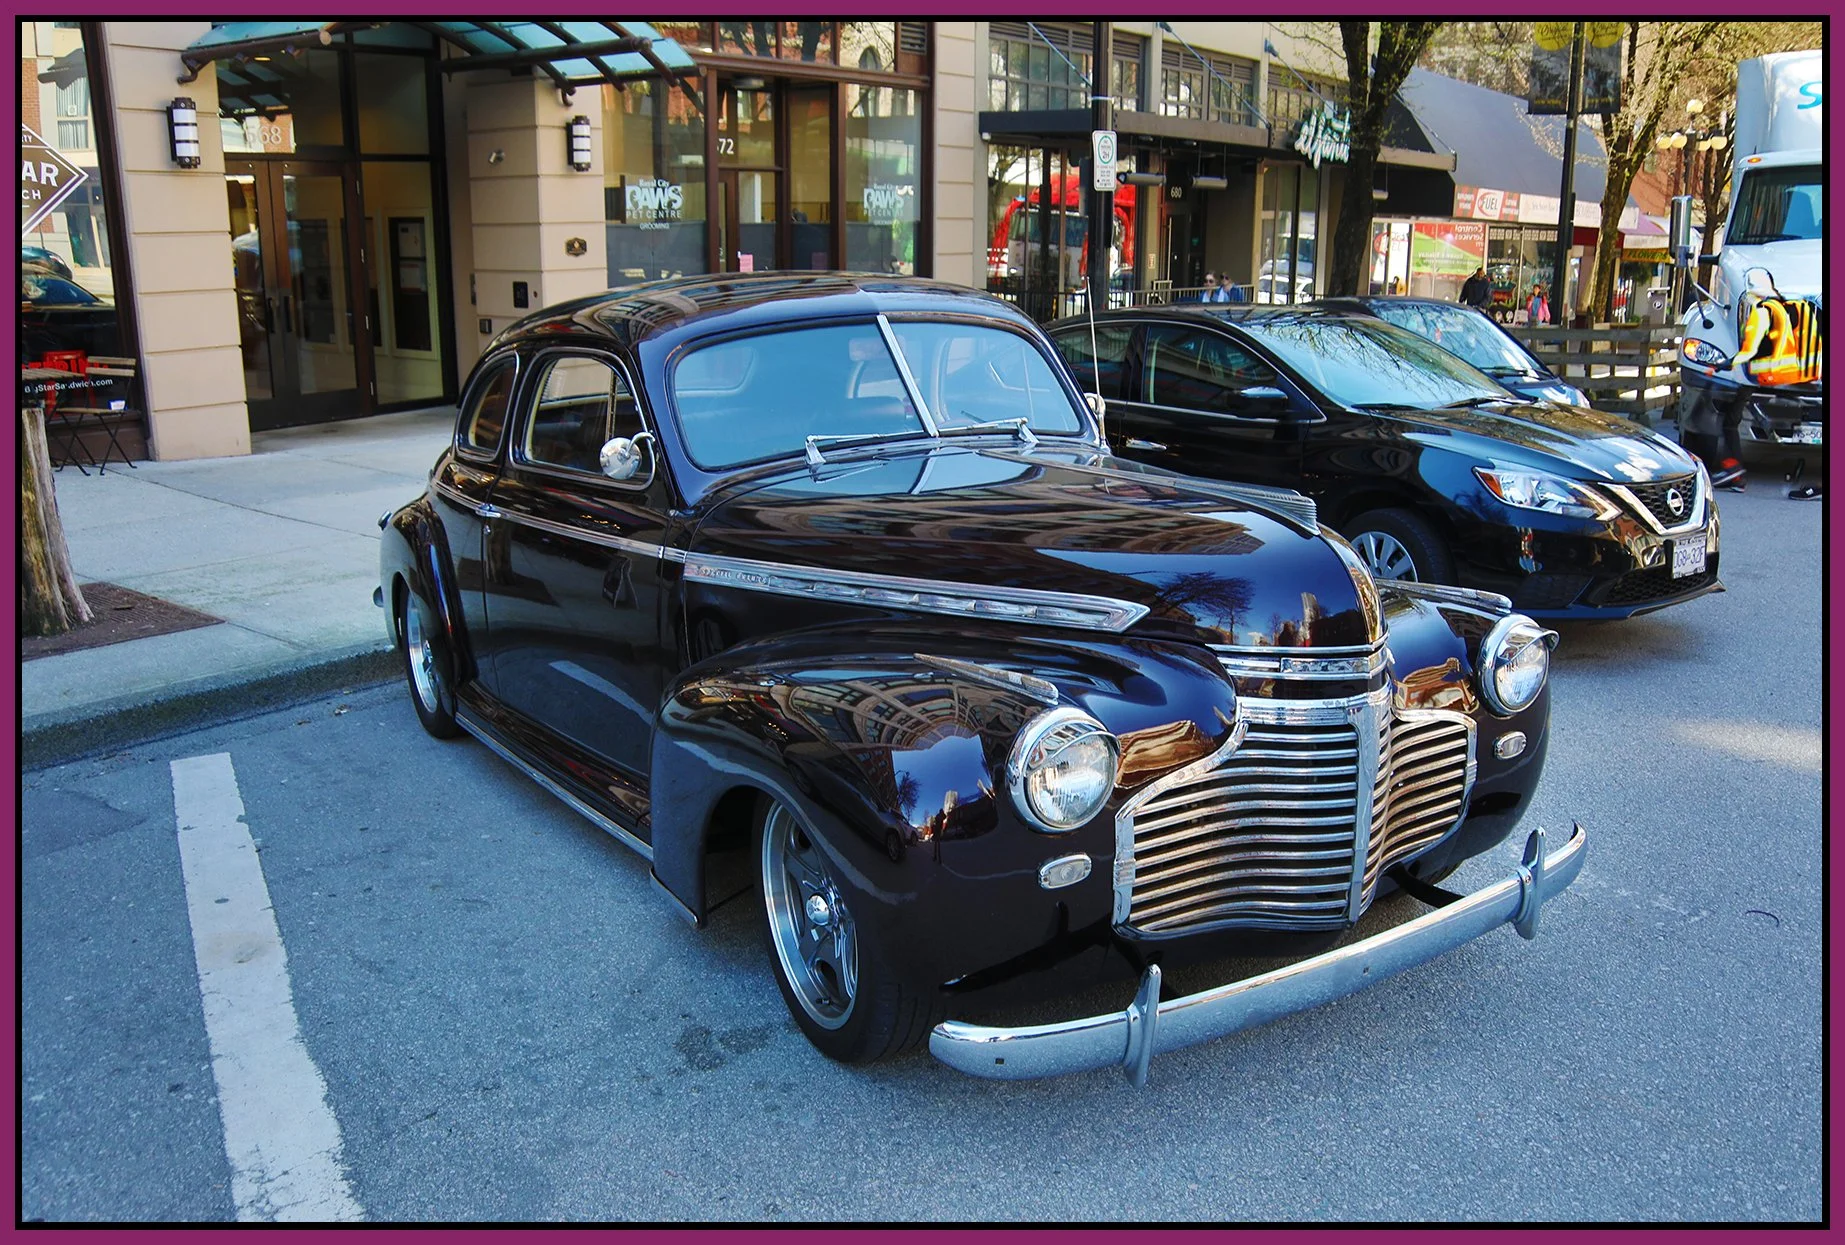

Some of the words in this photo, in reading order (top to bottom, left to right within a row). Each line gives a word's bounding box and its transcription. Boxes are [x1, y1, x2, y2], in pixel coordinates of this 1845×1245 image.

[1797, 81, 1822, 110] S
[717, 138, 735, 155] 72
[625, 185, 684, 210] PAWS
[863, 188, 904, 209] PAWS
[1170, 186, 1182, 198] 680
[626, 210, 643, 219] PET
[646, 210, 682, 219] CENTRE
[639, 222, 670, 231] GROOMING
